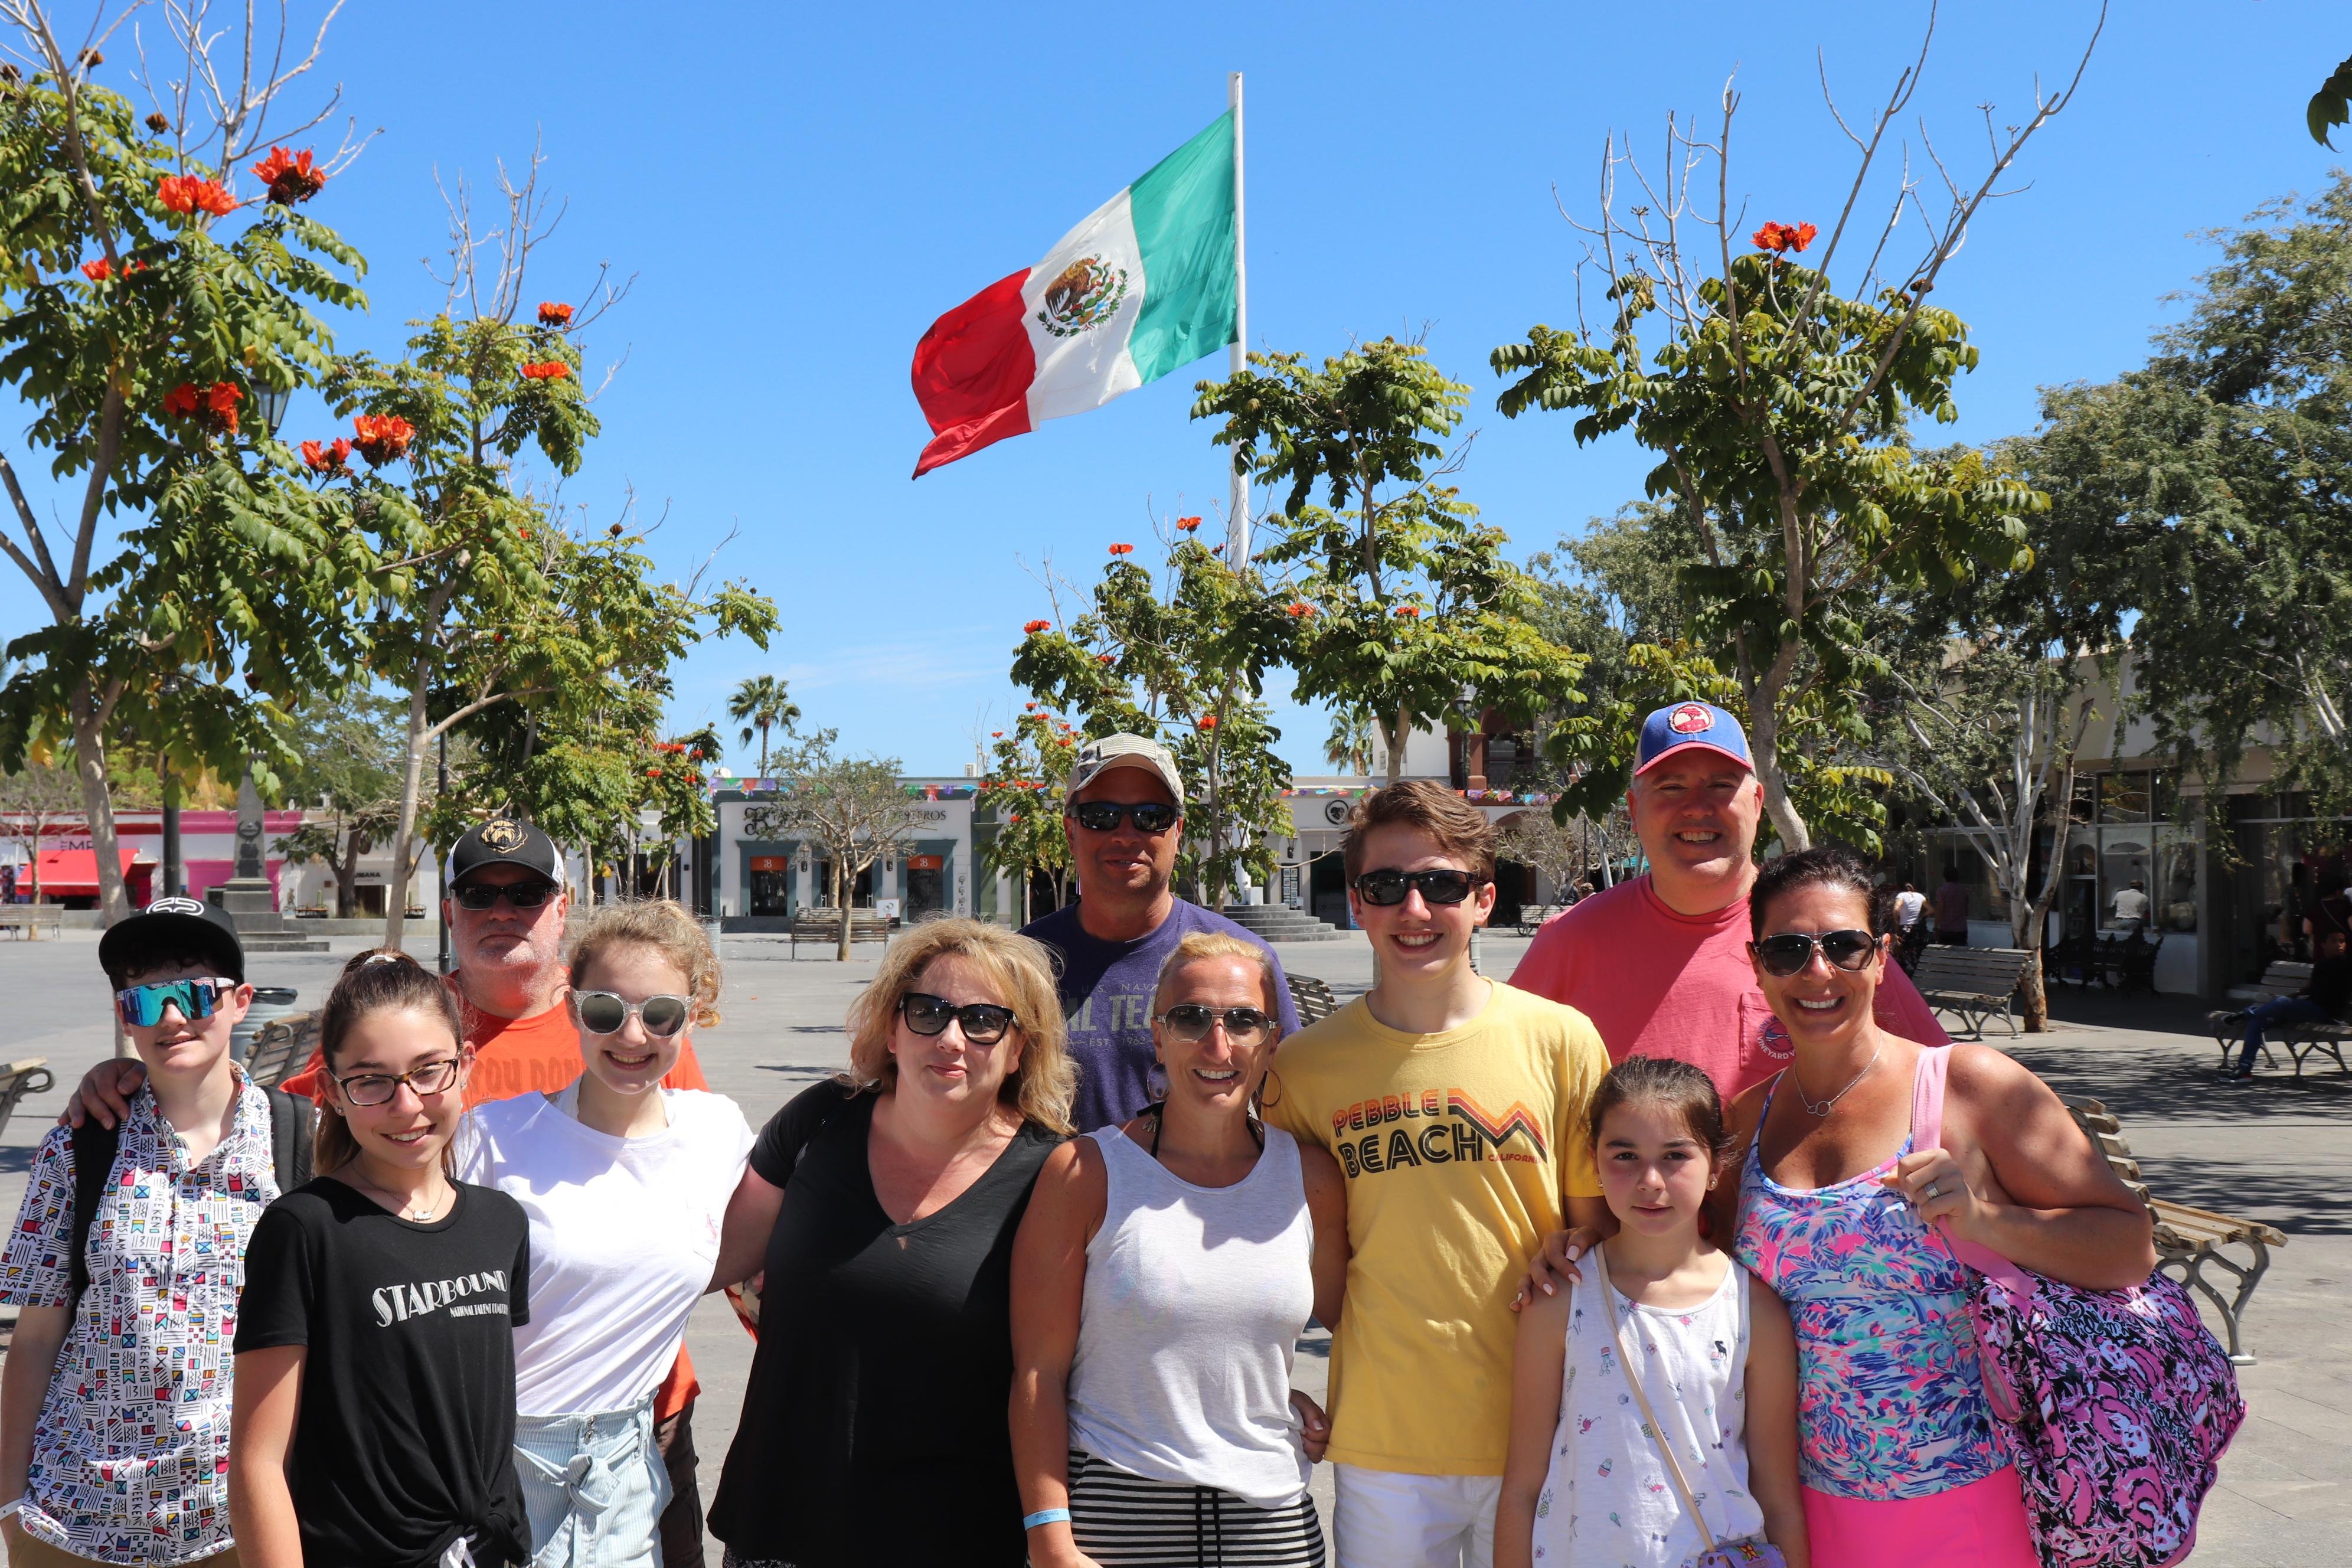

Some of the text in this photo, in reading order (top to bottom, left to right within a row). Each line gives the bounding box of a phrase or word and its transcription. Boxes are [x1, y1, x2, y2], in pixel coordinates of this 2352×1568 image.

[1122, 1036, 1146, 1046] 1962
[1332, 1089, 1440, 1138] PEBBLE
[1338, 1123, 1483, 1178] BEACH
[373, 1270, 507, 1328] STARBOUND
